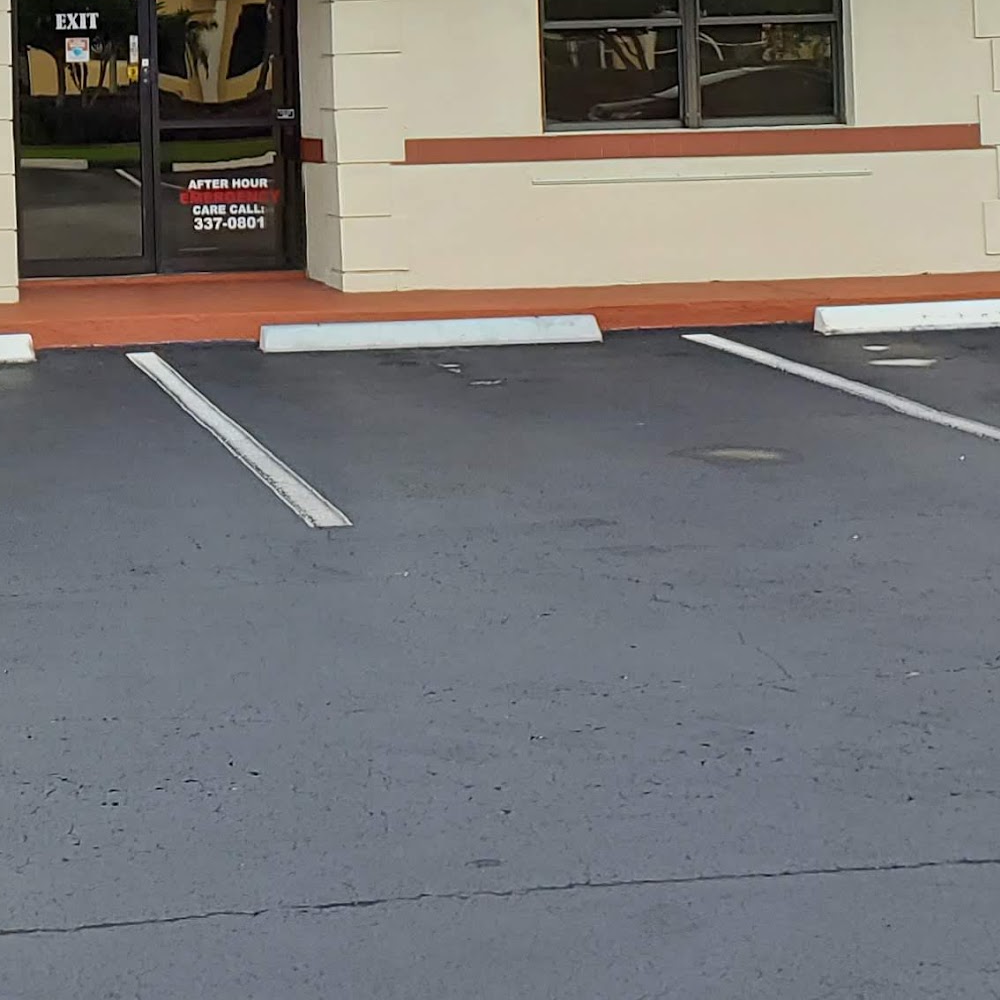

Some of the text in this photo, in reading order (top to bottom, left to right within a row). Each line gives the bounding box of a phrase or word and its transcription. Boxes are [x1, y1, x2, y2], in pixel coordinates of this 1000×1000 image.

[55, 12, 99, 30] EXIT
[188, 178, 268, 189] AFTER HOUR
[192, 203, 265, 215] CARE CALL:
[193, 216, 265, 230] 337-0801
